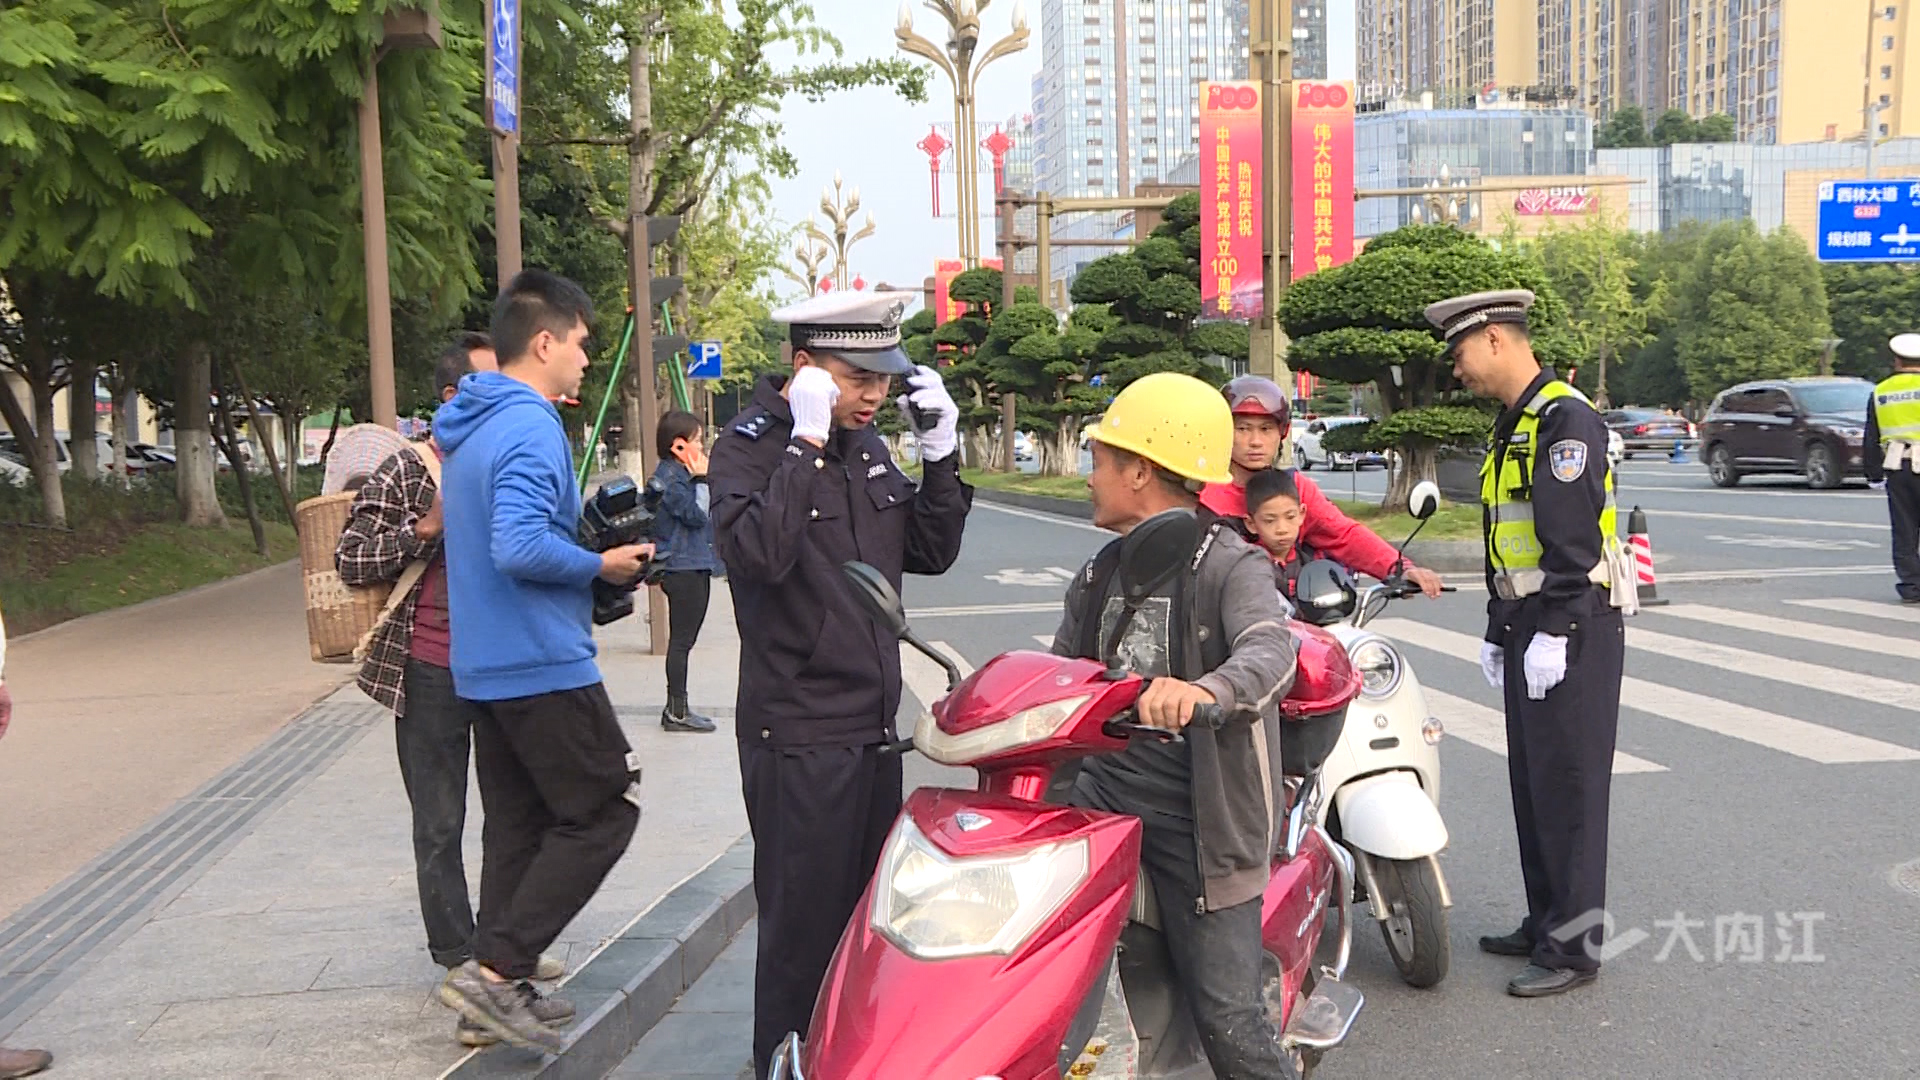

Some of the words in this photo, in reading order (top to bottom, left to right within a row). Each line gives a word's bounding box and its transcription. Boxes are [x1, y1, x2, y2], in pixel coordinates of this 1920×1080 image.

[1237, 161, 1253, 237] 热烈庆祝
[1837, 186, 1898, 203] 西林大道
[1212, 125, 1238, 314] 中国共产党成立100周年
[1827, 231, 1872, 247] 规划路
[702, 343, 719, 364] P
